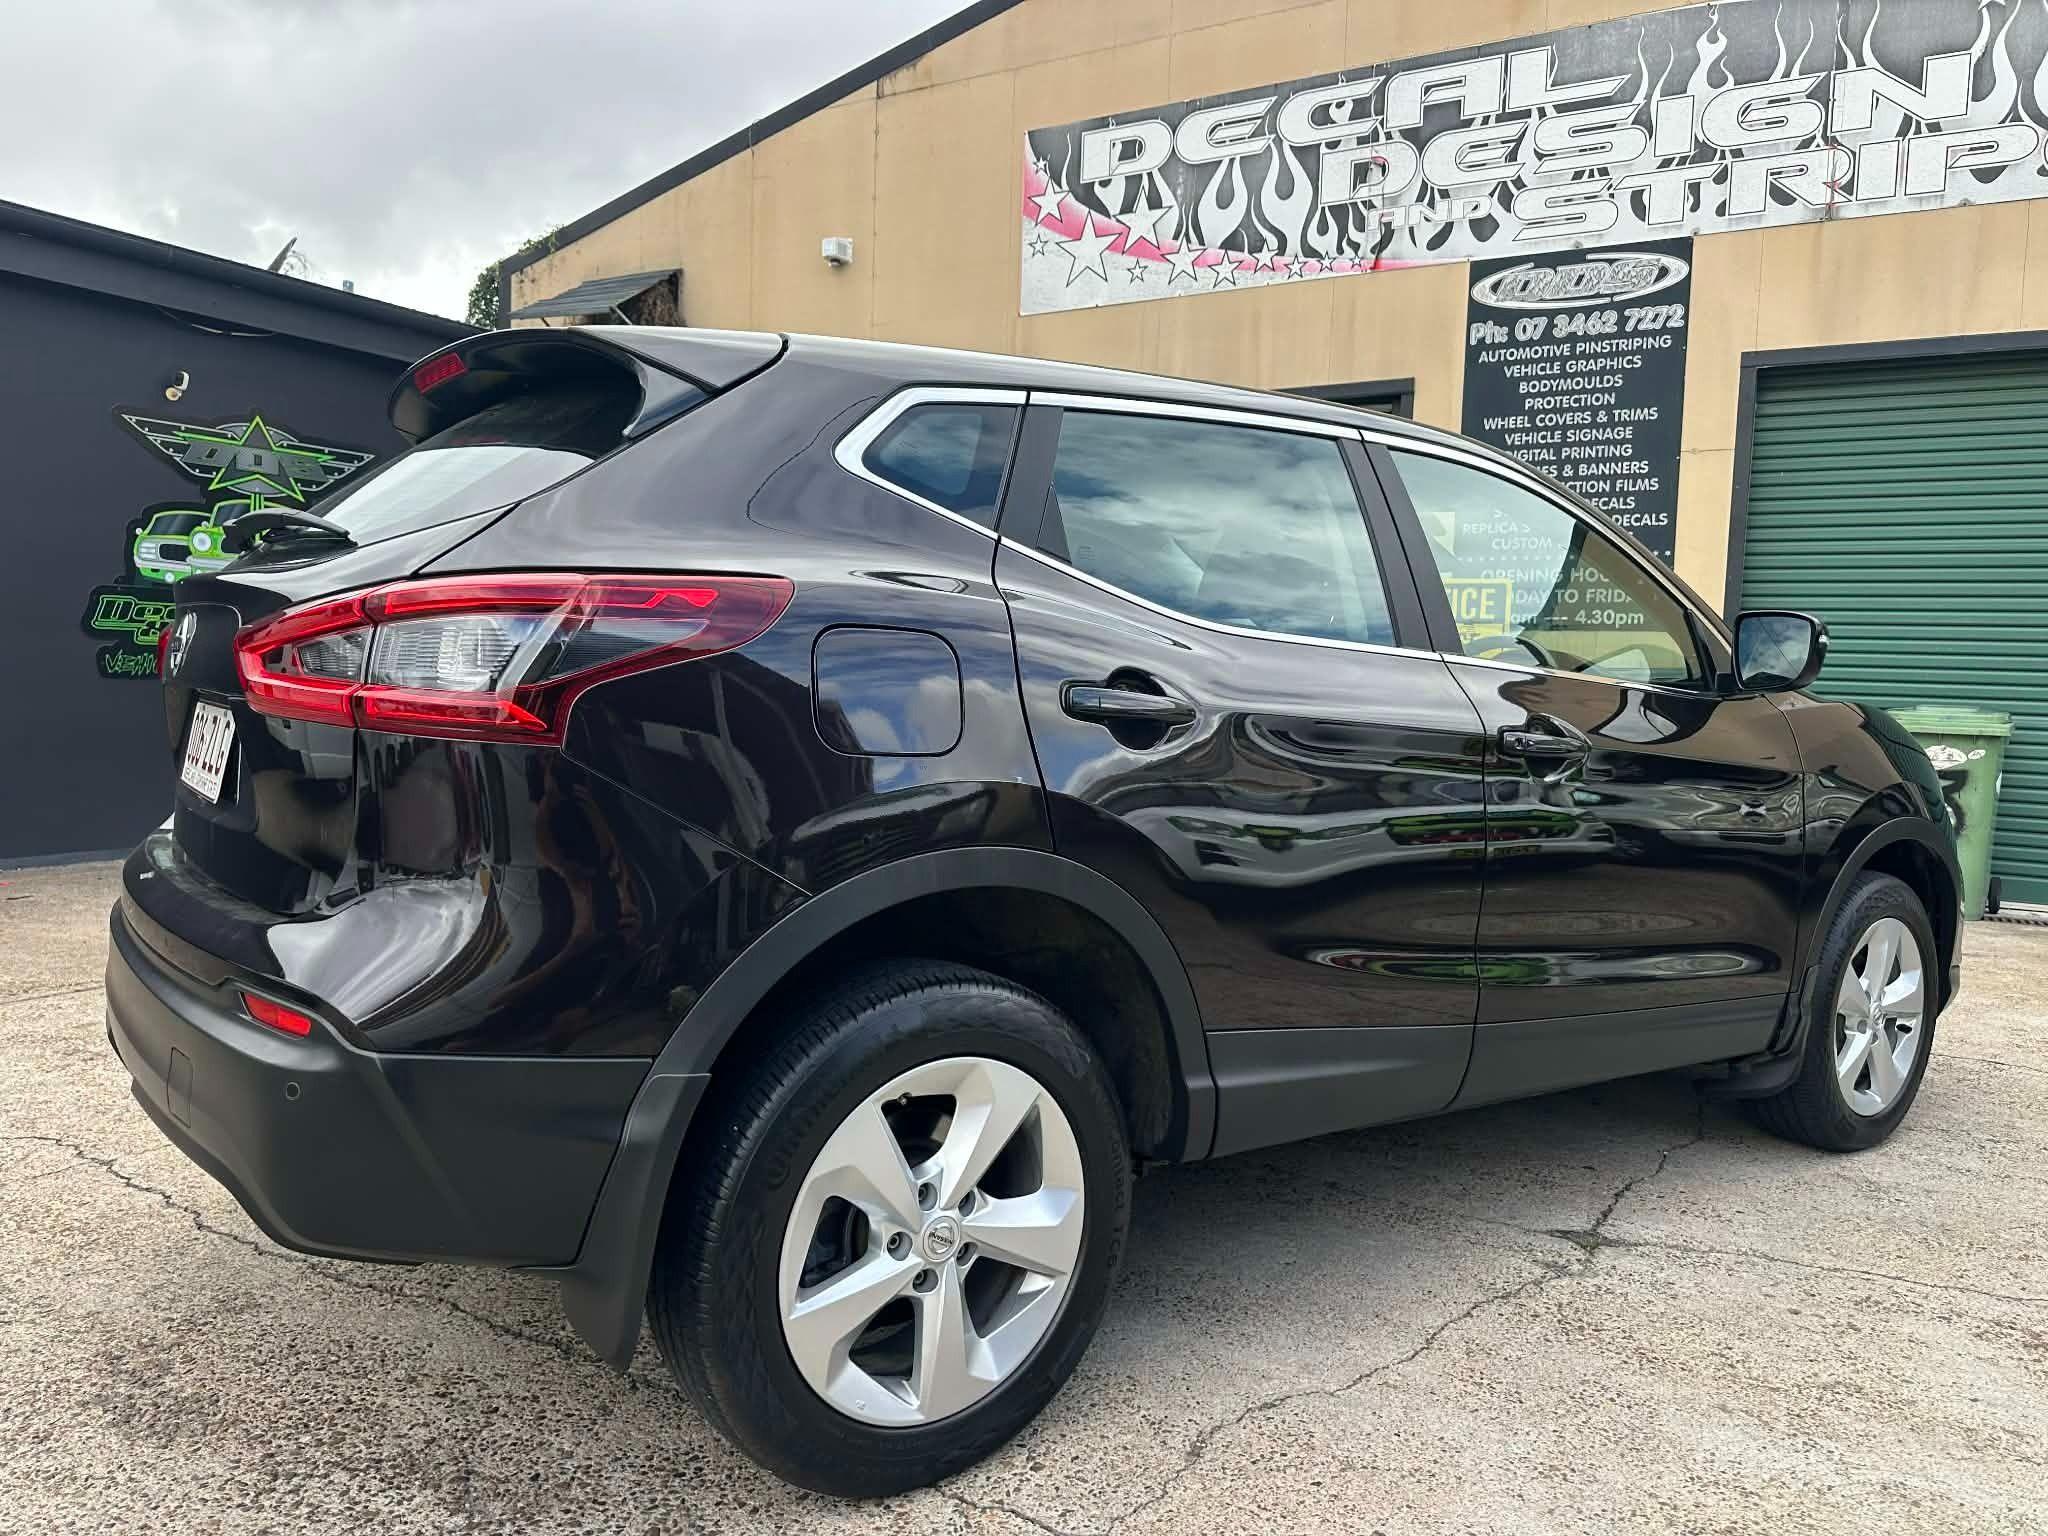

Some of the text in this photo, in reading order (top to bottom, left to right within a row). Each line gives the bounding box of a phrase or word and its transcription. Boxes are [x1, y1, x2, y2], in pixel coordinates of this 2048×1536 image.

[1080, 45, 1632, 183] DECAL
[1319, 51, 1973, 207] DESIGN
[1366, 121, 2048, 242] AND STRIP
[1514, 316, 1548, 341] 07
[1552, 309, 1618, 339] 3462
[1624, 303, 1685, 332] 7272
[1478, 334, 1672, 363] AUTOMOTIVE PINSTRIPING
[1503, 355, 1642, 378] VEHICLE GRAPHICS
[1519, 374, 1623, 394] BODYMOULDS
[1524, 392, 1616, 410] PROTECTION
[1484, 407, 1659, 431] WHEEL COVERS & TRIMS
[1504, 426, 1633, 446] VEHICLE SIGNAGE
[1561, 444, 1633, 460] PRINTING
[1562, 464, 1574, 477] &
[1578, 461, 1649, 476] BANNERS
[1615, 478, 1659, 493] FILMS
[1462, 520, 1519, 536] REPLICA
[1491, 535, 1552, 550] CUSTOM
[1480, 566, 1565, 583] OPENING
[1446, 587, 1497, 620] ICE
[1511, 589, 1550, 605] DAY
[1555, 588, 1579, 604] TO
[1575, 608, 1644, 629] 4.30pm
